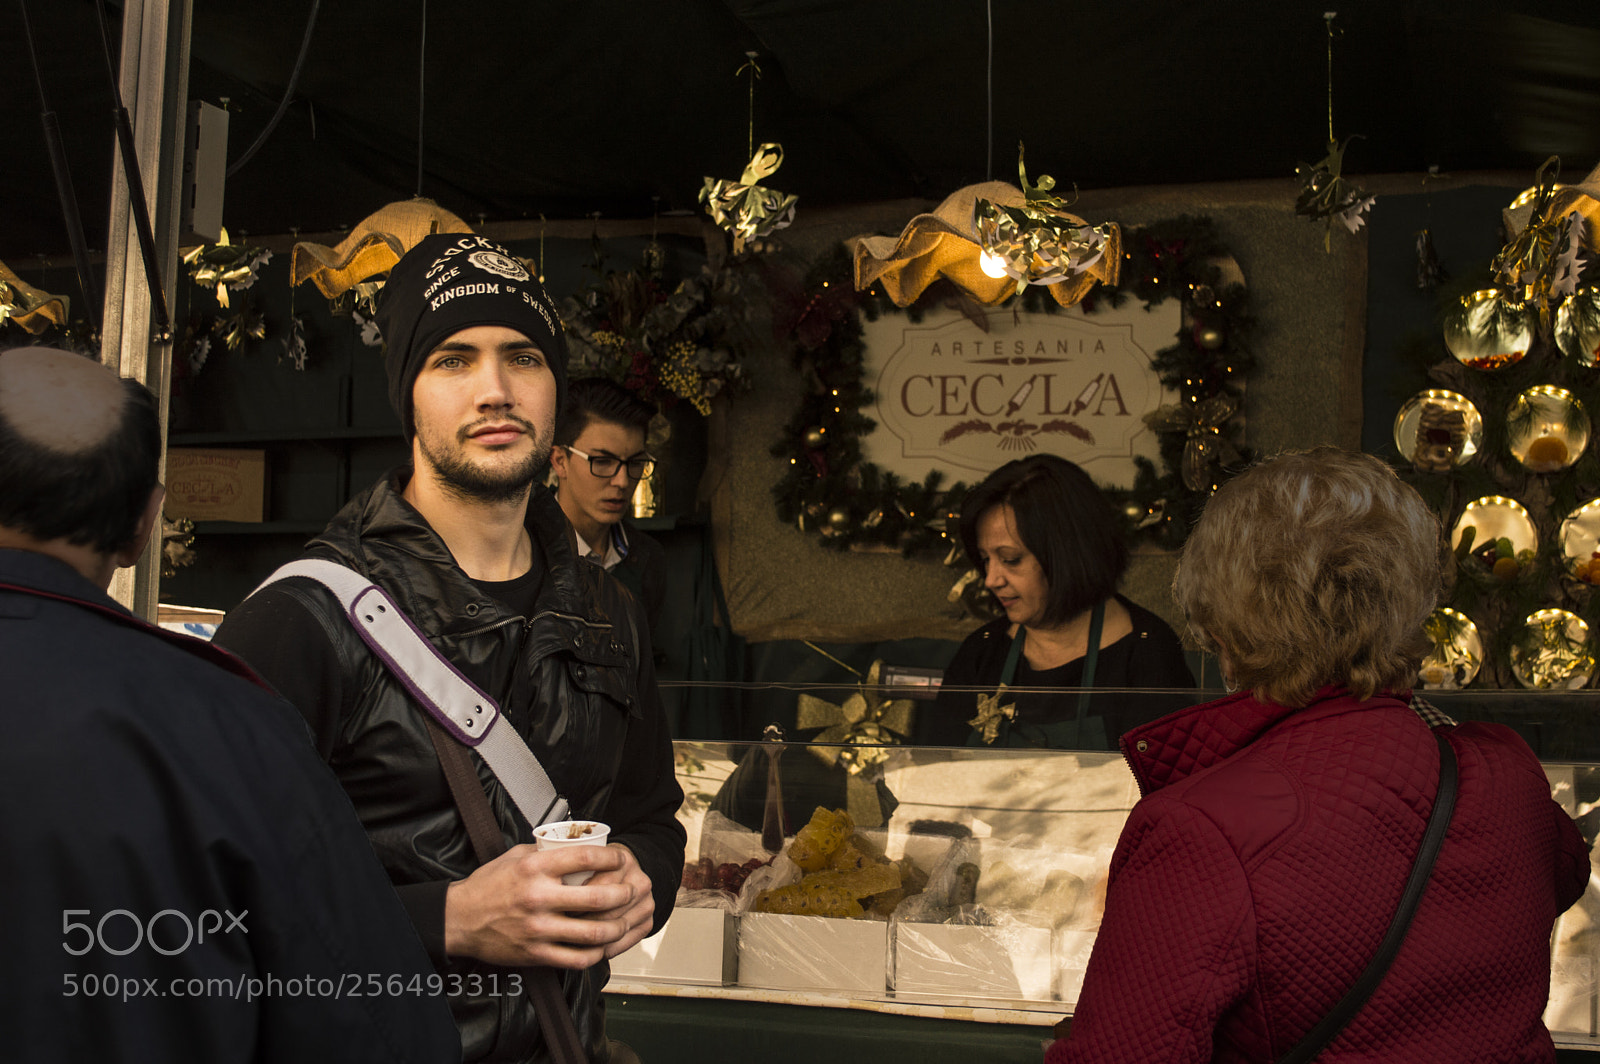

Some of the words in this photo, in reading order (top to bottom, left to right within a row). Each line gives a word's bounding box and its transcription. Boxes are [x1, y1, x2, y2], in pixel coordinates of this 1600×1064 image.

[425, 236, 523, 280] STOCKH
[424, 266, 461, 300] SINCE
[430, 282, 500, 312] KINGDOM
[506, 285, 517, 294] OF
[522, 291, 557, 337] SWEDEN
[931, 339, 1106, 357] ARTESANIA
[900, 372, 1131, 417] CECILIA
